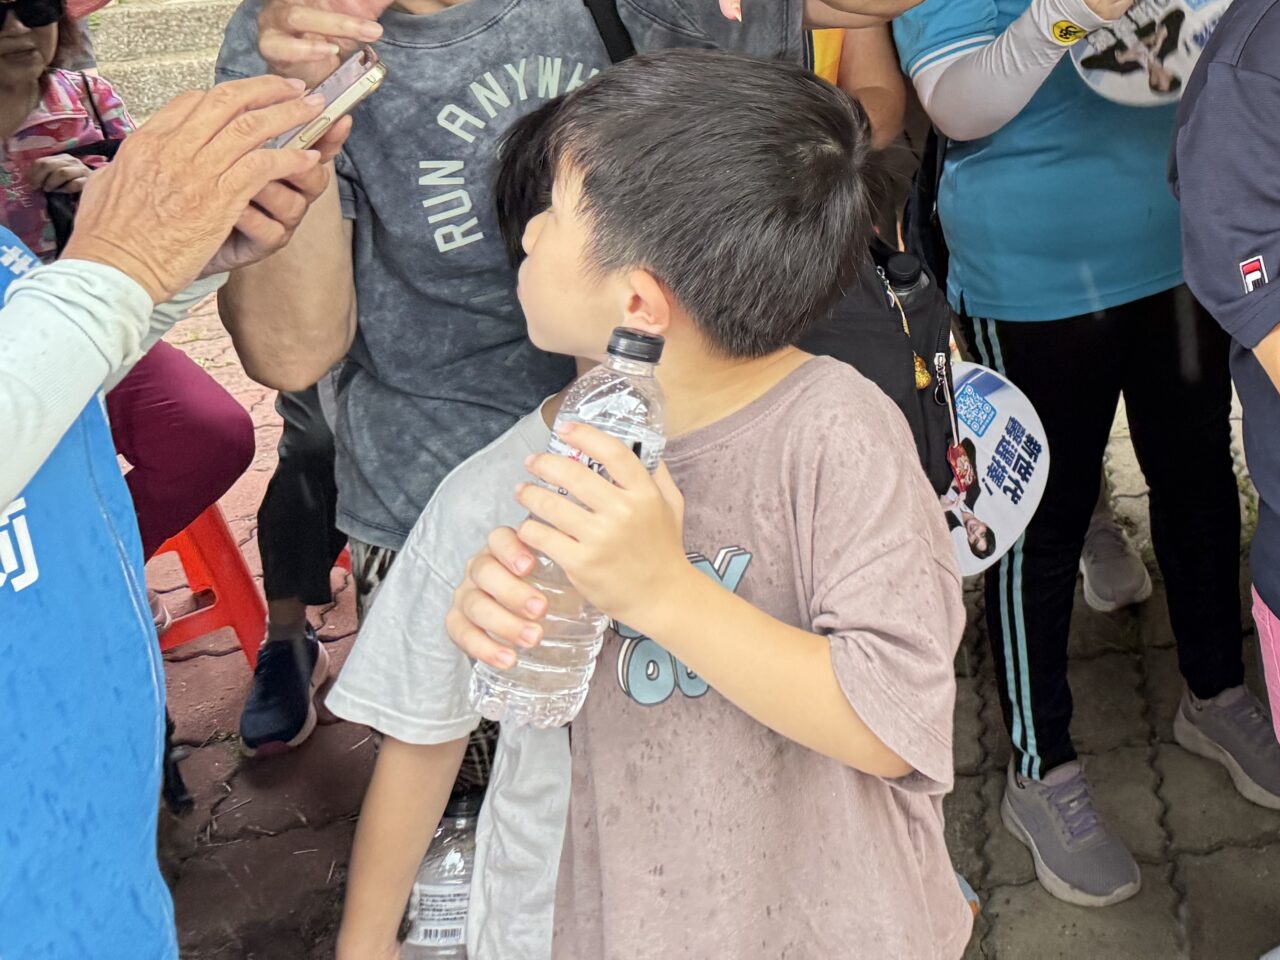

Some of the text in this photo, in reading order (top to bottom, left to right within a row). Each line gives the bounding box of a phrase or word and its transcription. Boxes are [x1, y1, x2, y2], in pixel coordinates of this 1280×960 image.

[418, 160, 484, 253] RUN
[1003, 433, 1043, 505] 新世代
